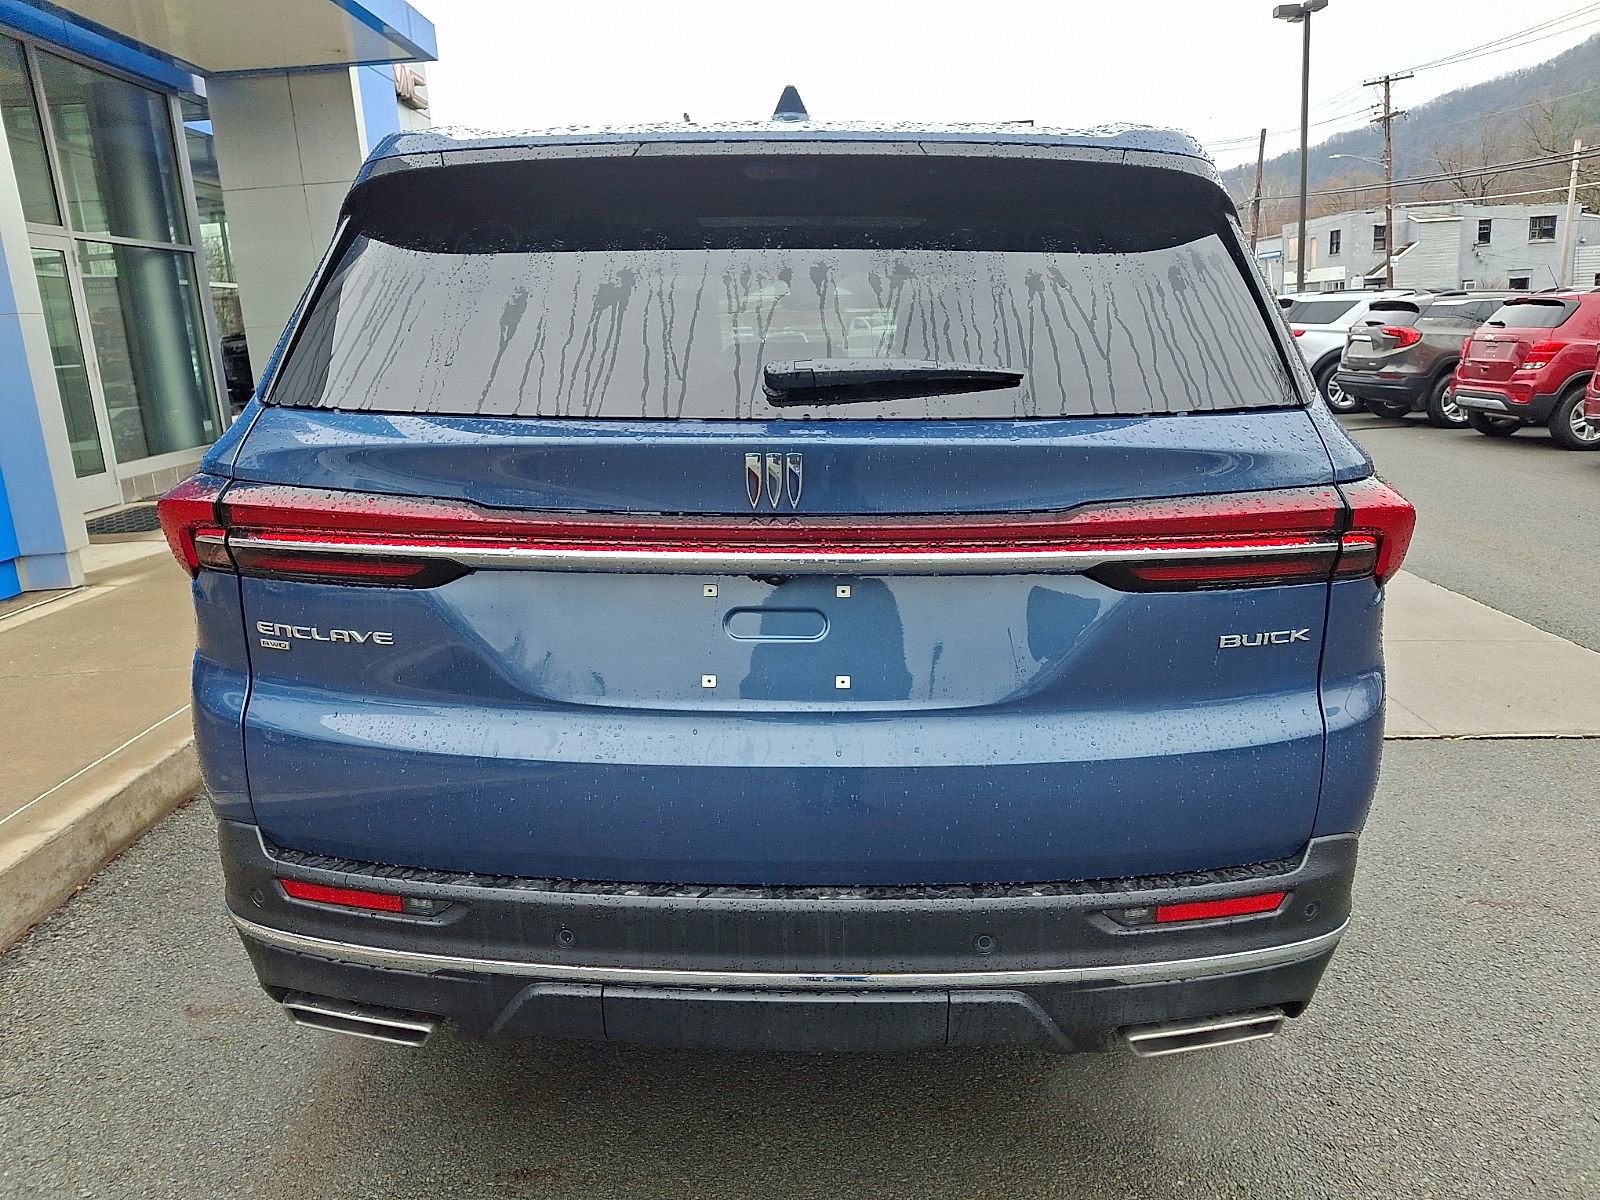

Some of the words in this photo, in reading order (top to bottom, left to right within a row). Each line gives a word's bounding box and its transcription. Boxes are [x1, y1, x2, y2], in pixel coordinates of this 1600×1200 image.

[256, 621, 394, 645] ENCLAVE
[1219, 628, 1310, 649] BUICK
[261, 639, 289, 649] AWD
